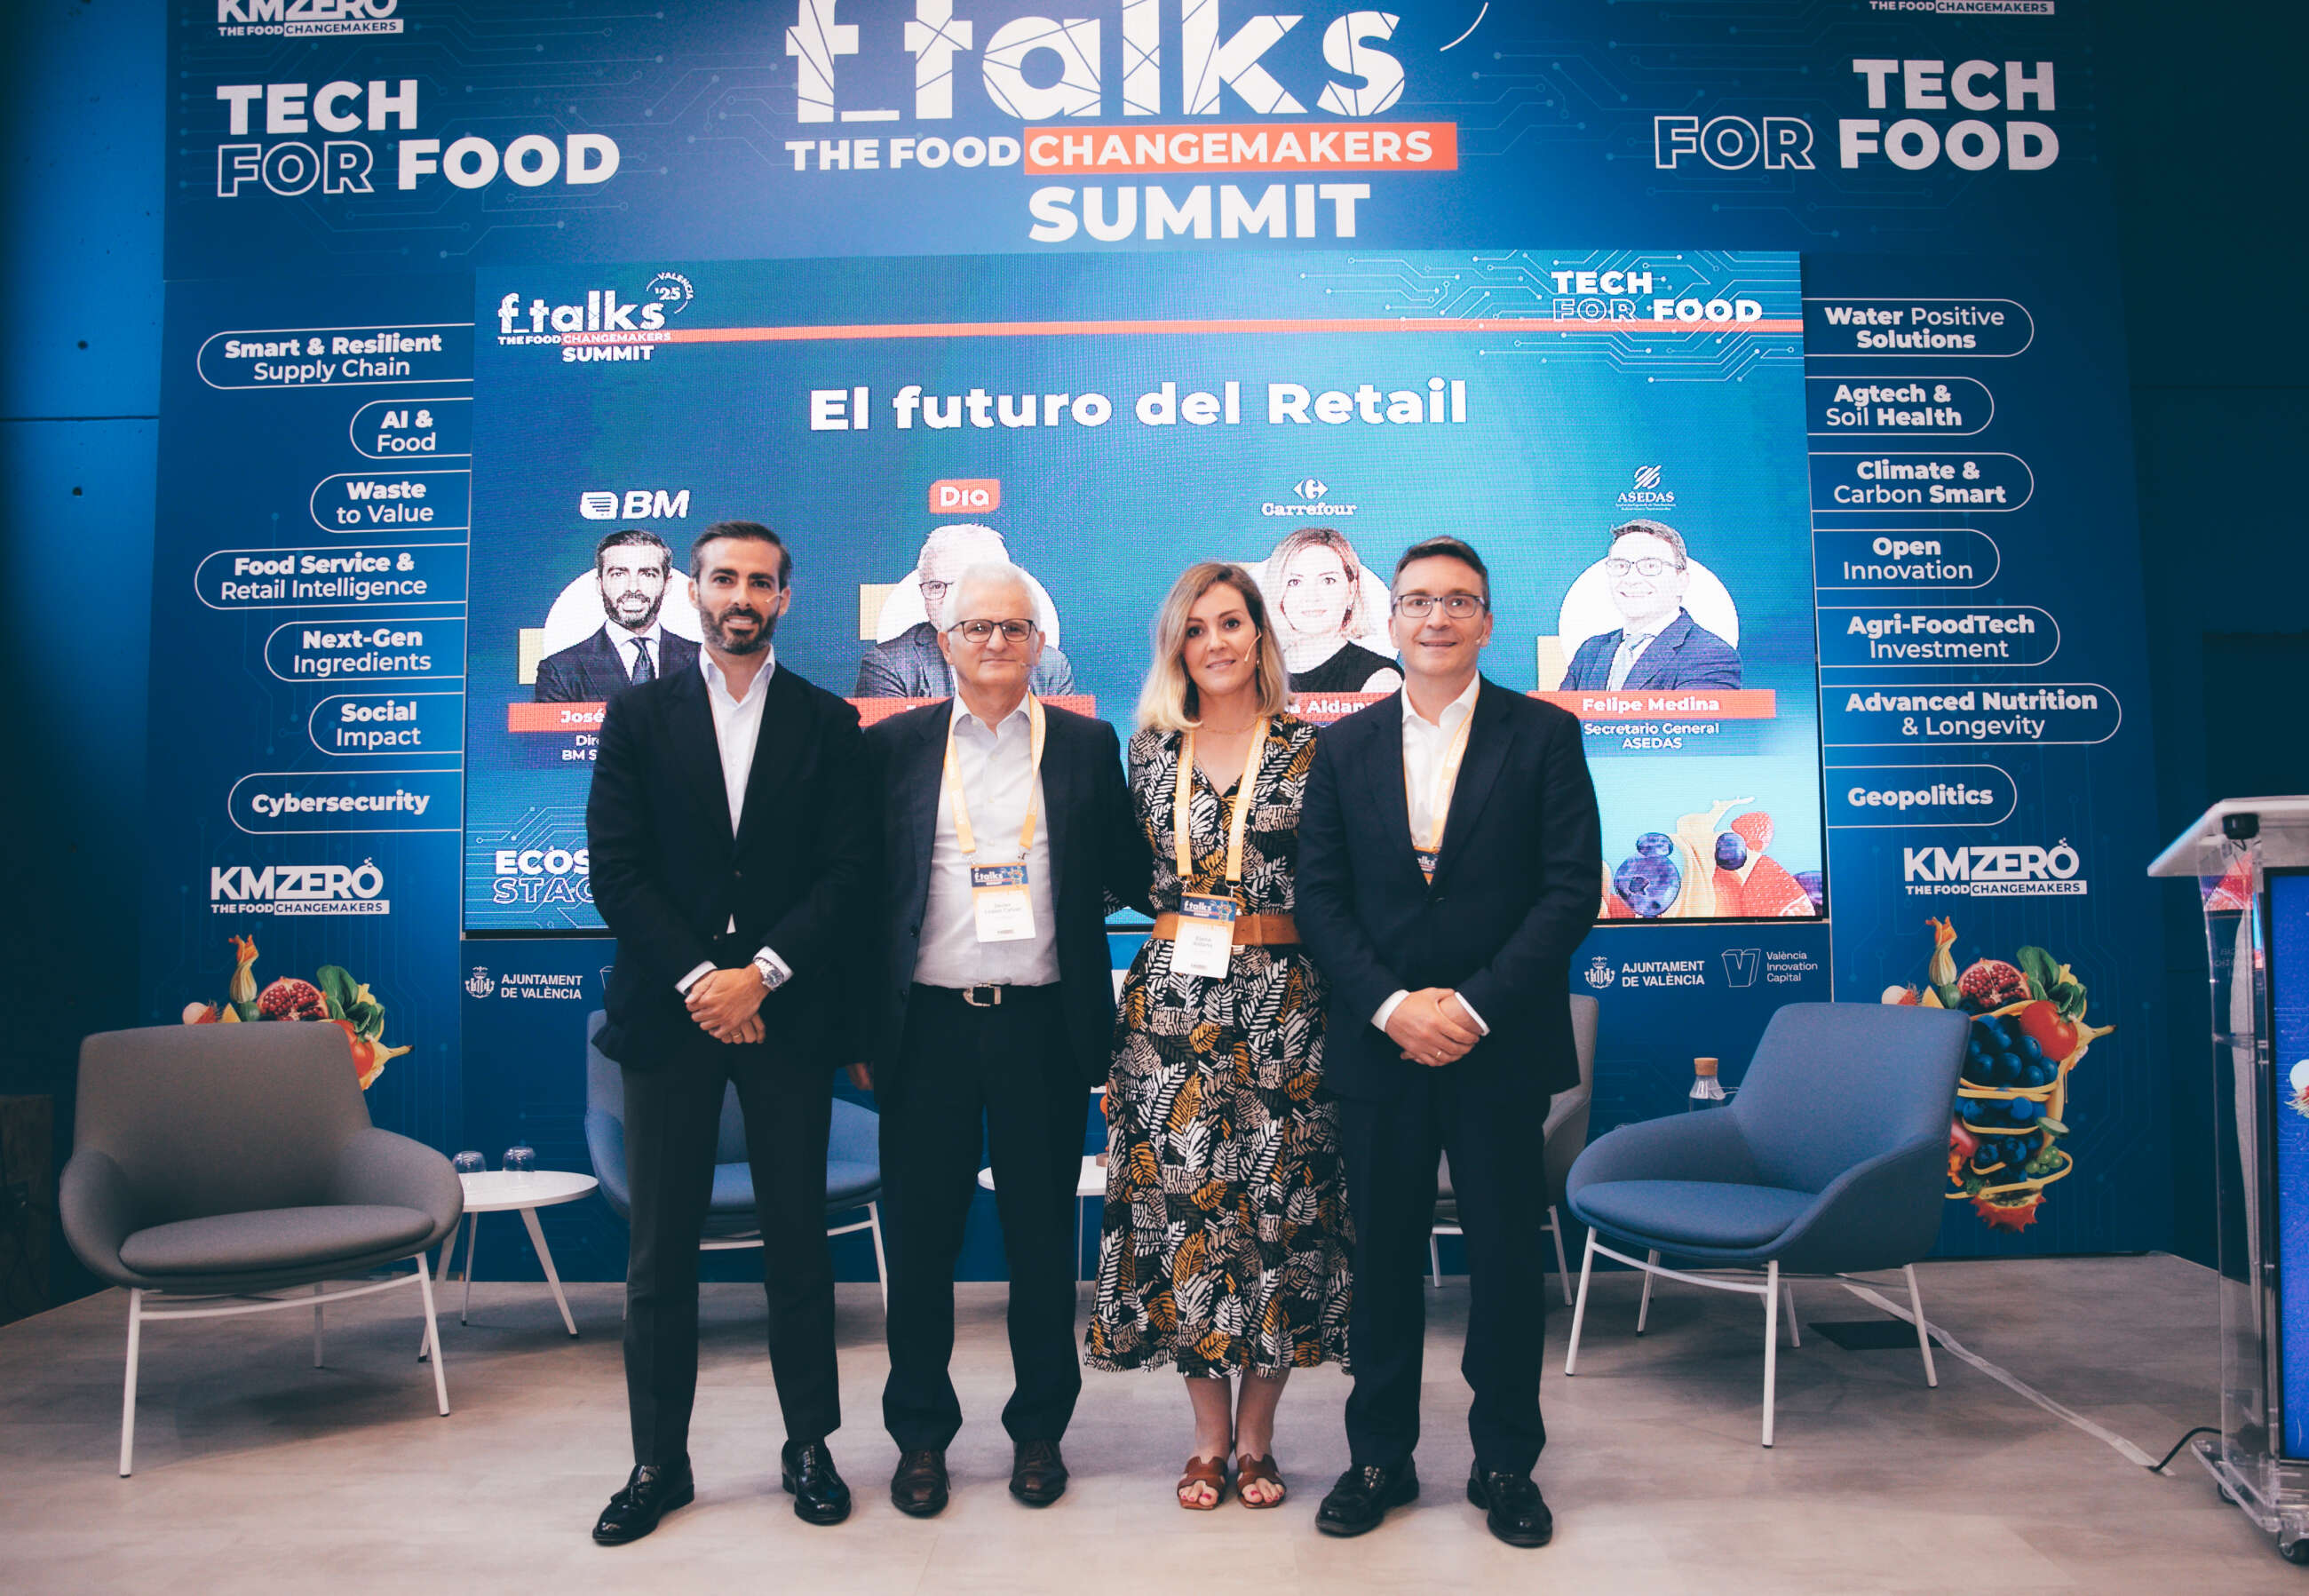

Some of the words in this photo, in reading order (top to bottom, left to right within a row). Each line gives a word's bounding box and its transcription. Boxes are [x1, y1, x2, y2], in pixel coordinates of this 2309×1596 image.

[1870, 0, 1896, 11] THE
[1899, 0, 1935, 11] FOOD
[1937, 2, 2048, 12] CHANGEMAKERS
[218, 27, 244, 36] THE
[247, 26, 283, 36] FOOD
[286, 21, 396, 35] CHANGEMAKERS
[1853, 60, 2055, 110] TECH
[217, 80, 417, 135] TECH
[785, 139, 879, 171] THE
[891, 137, 1020, 168] FOOD
[1029, 131, 1432, 166] CHANGEMAKERS
[1654, 116, 1815, 170] FOR
[1839, 119, 2059, 171] FOOD
[218, 140, 374, 197] FOR
[399, 133, 620, 190] FOOD
[1029, 184, 1369, 242] SUMMIT
[1551, 271, 1653, 294] TECH
[1552, 298, 1636, 322] FOR
[1654, 298, 1763, 322] FOOD
[1825, 307, 1903, 325] Water
[1911, 306, 2004, 325] Positive
[226, 339, 300, 358] Smart
[307, 337, 324, 355] &
[332, 332, 441, 354] Resilient
[497, 336, 524, 345] THE
[525, 335, 561, 345] FOOD
[563, 332, 671, 344] CHANGEMAKERS
[1857, 328, 1976, 348] Solutions
[562, 345, 654, 362] SUMMIT
[254, 360, 336, 383] Supply
[342, 357, 409, 377] Chain
[811, 387, 868, 430] El
[892, 384, 1113, 427] futuro
[1135, 380, 1241, 425] del
[1268, 377, 1467, 423] Retail
[1834, 384, 1926, 407] Agtech
[1933, 385, 1951, 402] &
[381, 410, 408, 429] AI
[415, 409, 432, 428] &
[1827, 407, 1869, 425] Soil
[1877, 408, 1962, 425] Health
[377, 432, 435, 452] Food
[1857, 459, 1955, 480] Climate
[1963, 462, 1980, 480] &
[346, 481, 426, 500] Waste
[940, 487, 989, 506] Dia
[1617, 491, 1675, 503] ASEDAS
[1834, 484, 1921, 503] Carbon
[1930, 485, 2006, 503] Smart
[337, 507, 361, 523] to
[368, 504, 433, 522] Value
[622, 489, 690, 520] BM
[1261, 502, 1357, 516] Carrefour
[1873, 537, 1940, 560] Open
[234, 555, 295, 576] Food
[300, 552, 391, 574] Service
[396, 552, 414, 571] &
[1845, 560, 1972, 579] Innovation
[222, 579, 285, 599] Retail
[293, 576, 427, 600] Intelligence
[1847, 614, 2035, 639] Agri-FoodTech
[303, 629, 423, 648] Next-Gen
[1870, 640, 2009, 658] Investment
[295, 652, 431, 677] Ingredients
[1306, 700, 1374, 713] Aldan
[1583, 698, 1642, 713] Felipe
[1648, 697, 1719, 711] Medina
[1845, 691, 1975, 711] Advanced
[1982, 689, 2097, 710] Nutrition
[341, 700, 417, 722] Social
[560, 708, 605, 723] José
[1583, 723, 1658, 735] Secretario
[1662, 723, 1719, 734] General
[1902, 718, 1918, 735] &
[1926, 715, 2044, 739] Longevity
[337, 727, 421, 750] Impact
[1622, 737, 1682, 749] ASEDAS
[562, 749, 585, 761] BM
[252, 790, 430, 817] Cybersecurity
[1848, 783, 1993, 810] Geopolitics
[496, 848, 589, 875] ECOS
[1905, 886, 1932, 895] THE
[1933, 885, 1969, 895] FOOD
[1971, 884, 2080, 894] CHANGEMAKERS
[211, 904, 237, 914] THE
[238, 903, 274, 914] FOOD
[275, 902, 383, 913] CHANGEMAKERS
[1623, 961, 1704, 973] AJUNTAMENT
[1767, 962, 1818, 971] Innovation
[502, 974, 583, 985] AJUNTAMENT
[1623, 976, 1639, 987] DE
[1643, 973, 1704, 986] VALÈNCIA
[1767, 973, 1801, 983] Capital
[501, 988, 517, 997] DE
[521, 986, 582, 999] VALÈNCIA
